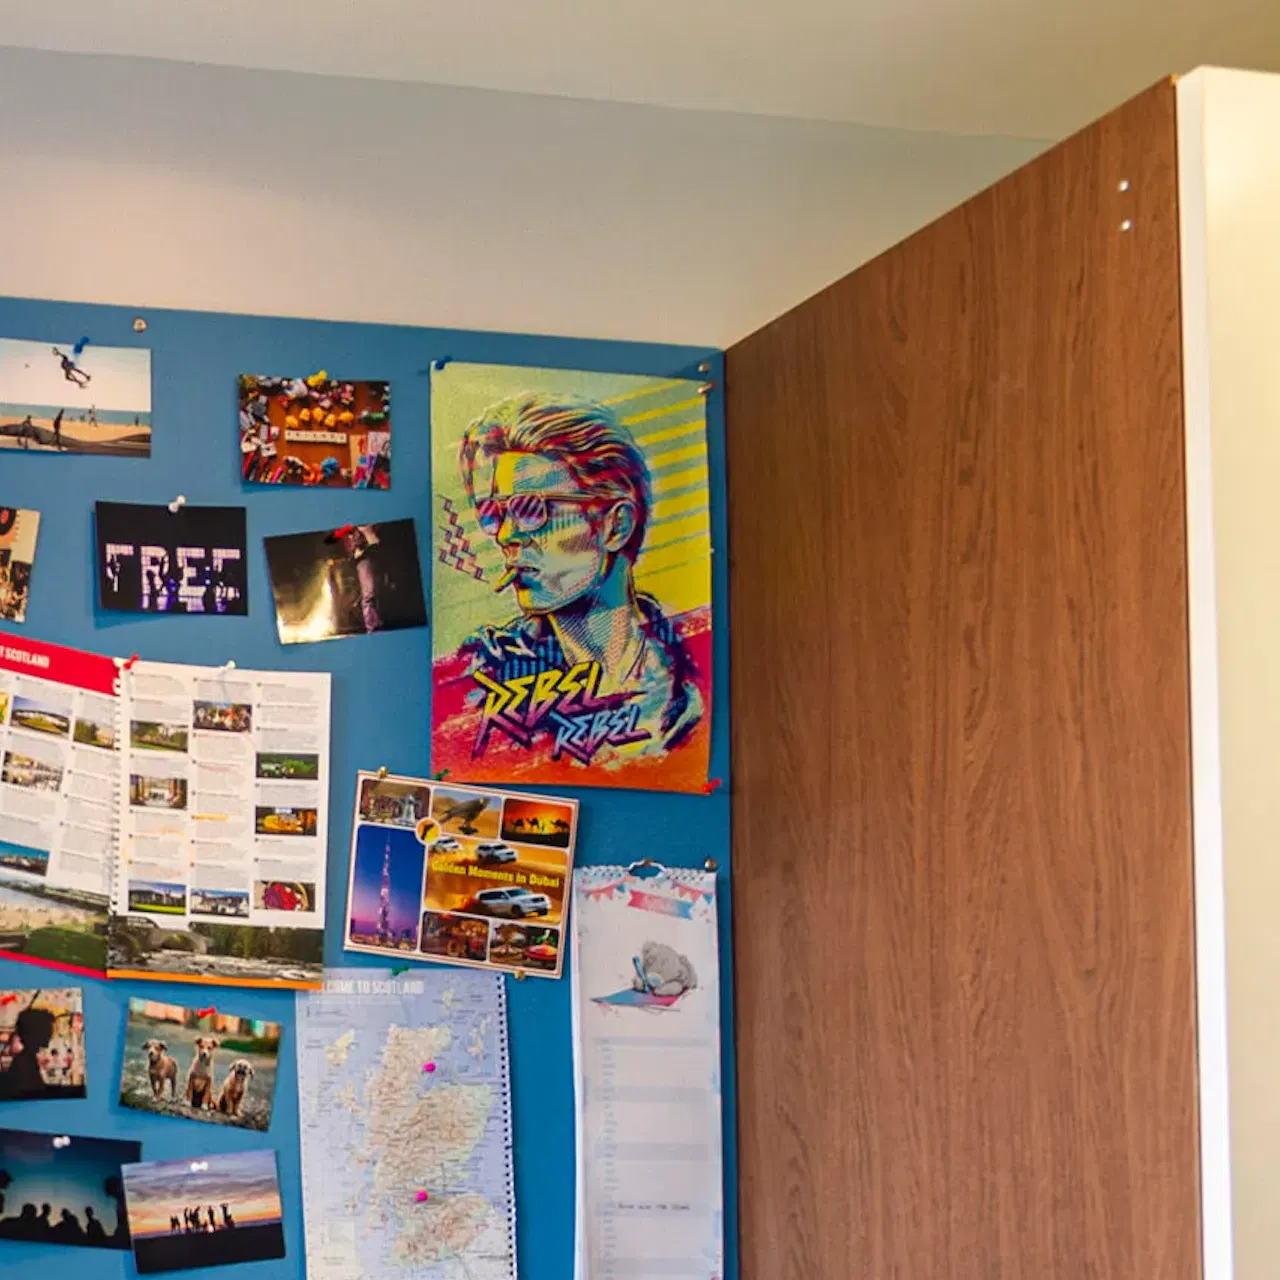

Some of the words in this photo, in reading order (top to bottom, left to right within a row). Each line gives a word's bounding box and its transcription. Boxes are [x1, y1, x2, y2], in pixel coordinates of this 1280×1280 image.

[4, 646, 50, 669] SCOTLAND
[472, 661, 647, 760] REBEL
[549, 704, 652, 766] REBEL
[432, 860, 467, 876] Golden
[468, 865, 515, 883] Moments
[529, 873, 560, 889] Dubai
[357, 979, 370, 994] TO
[371, 979, 425, 994] SCOTLAND
